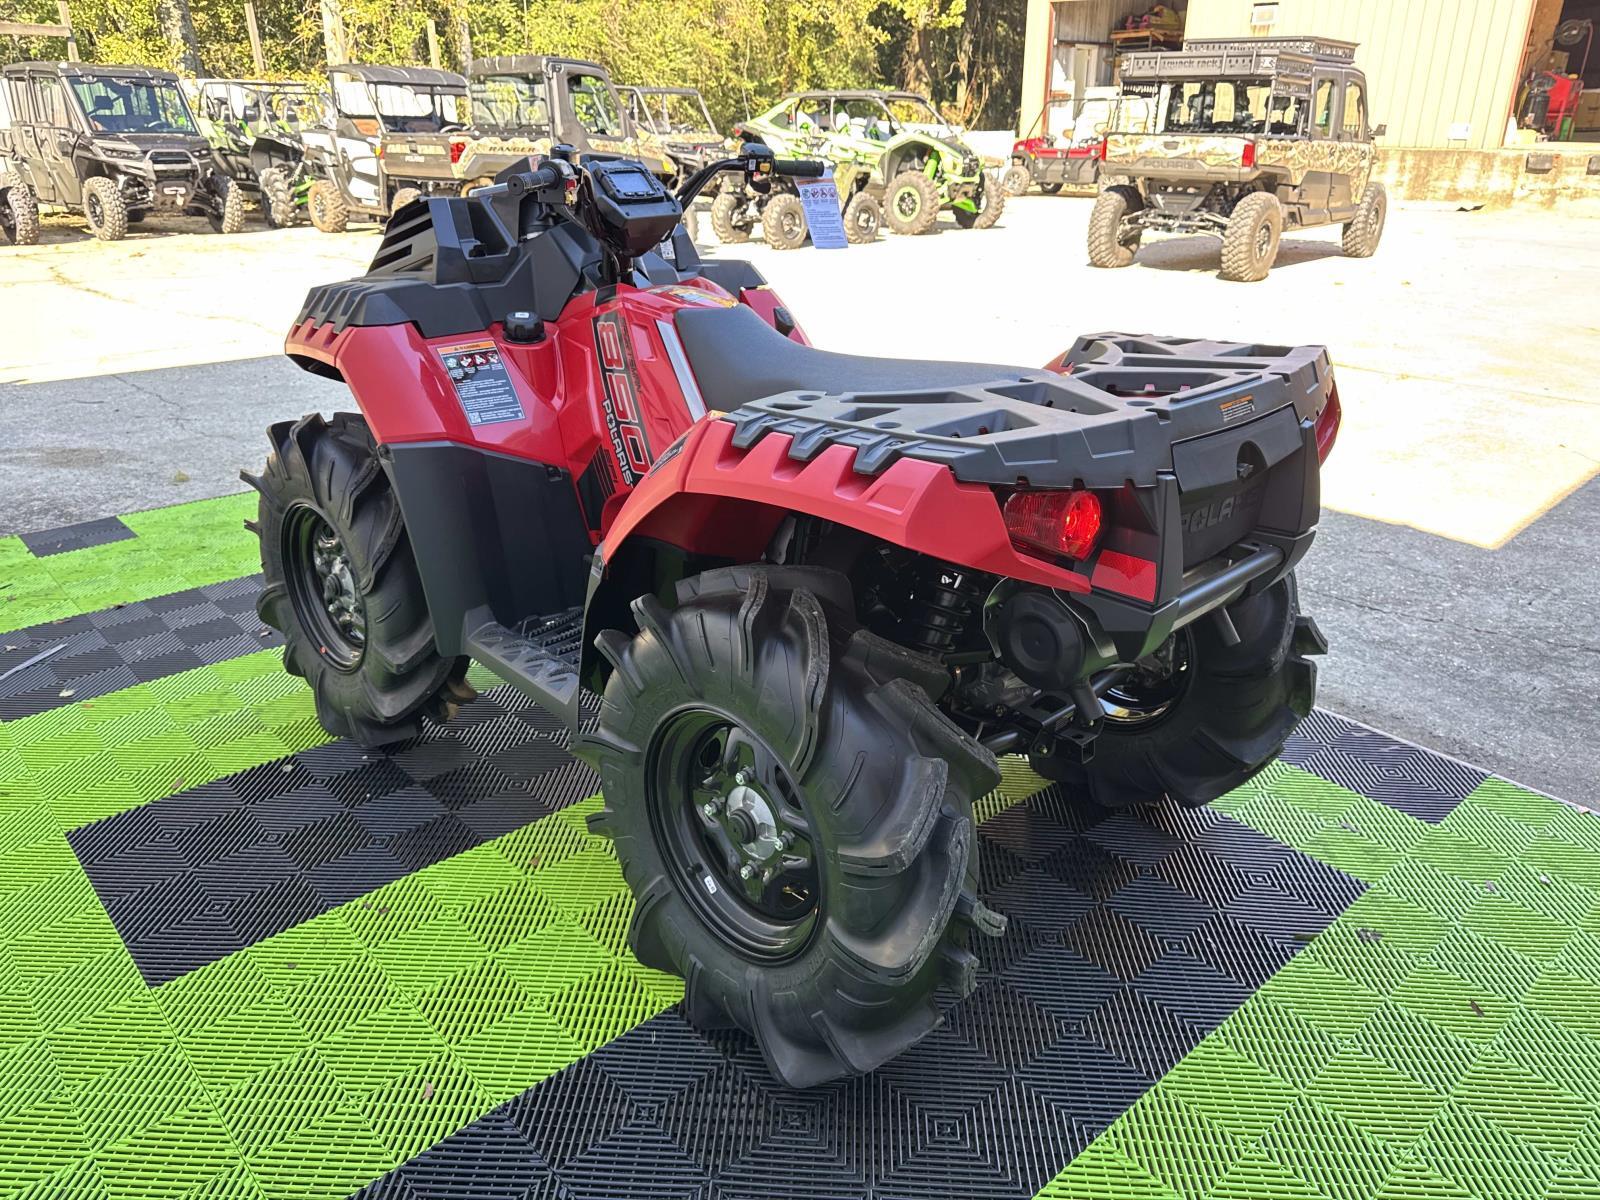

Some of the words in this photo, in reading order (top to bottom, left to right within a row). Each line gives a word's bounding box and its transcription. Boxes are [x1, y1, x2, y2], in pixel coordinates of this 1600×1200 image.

[1143, 159, 1196, 170] POLARIS
[596, 321, 652, 475] 850
[603, 399, 633, 486] POLARIS
[1182, 494, 1252, 532] POLA
